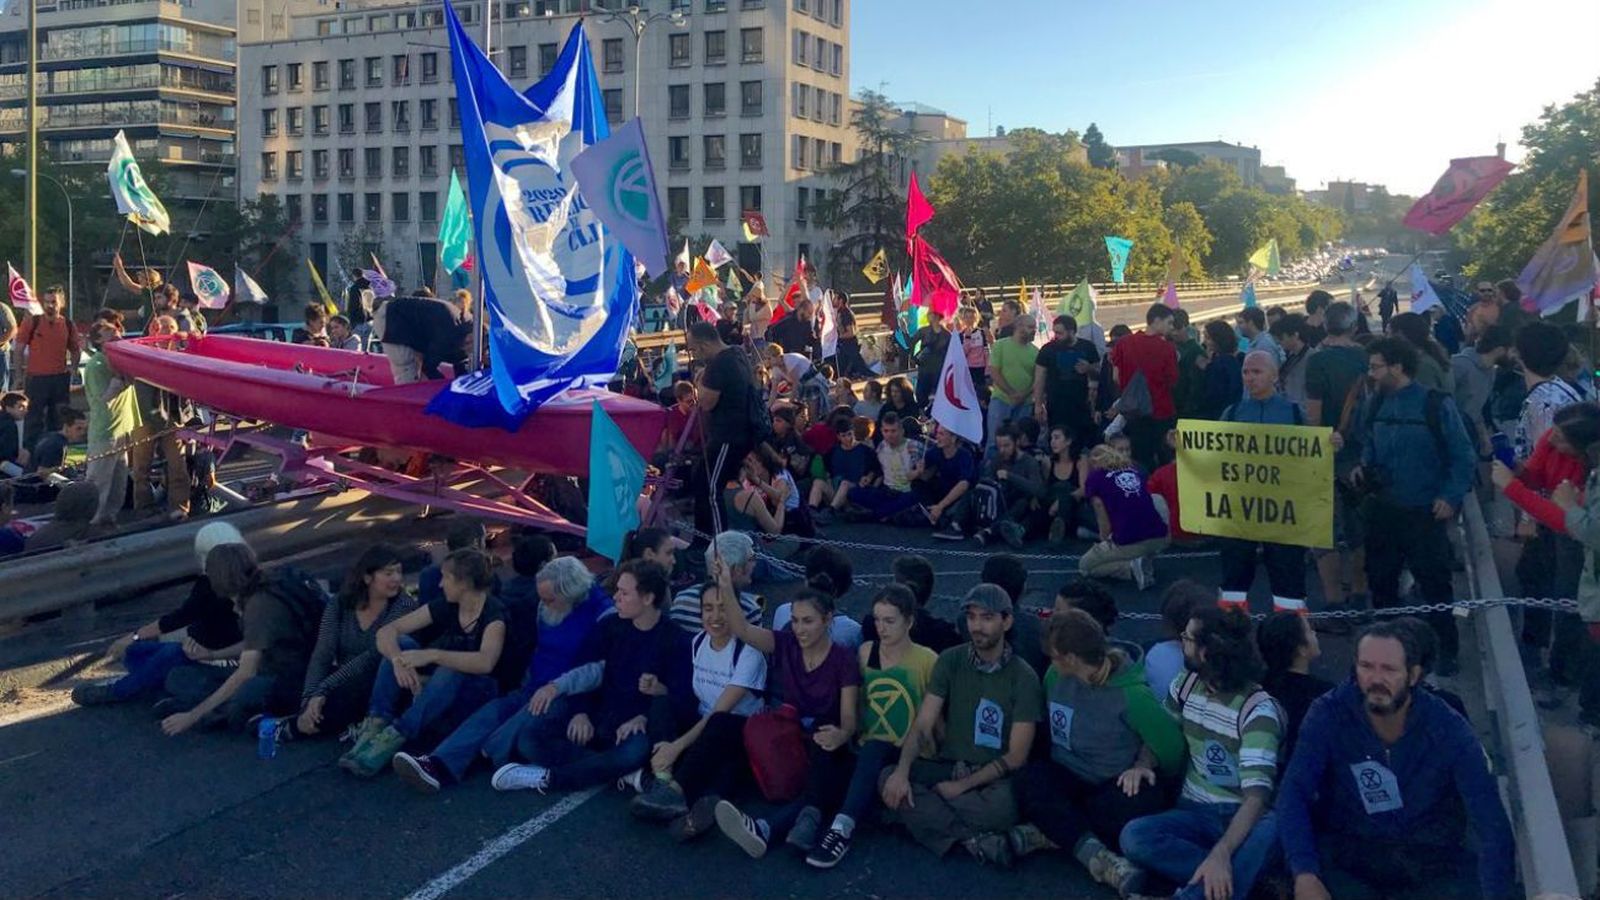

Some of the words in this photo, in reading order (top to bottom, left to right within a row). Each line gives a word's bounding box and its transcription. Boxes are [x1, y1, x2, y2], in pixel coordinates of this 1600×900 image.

[522, 187, 567, 203] 2020
[1182, 431, 1260, 456] NUESTRA
[1264, 434, 1322, 458] LUCHA
[1221, 462, 1240, 482] ES
[1245, 464, 1281, 486] POR
[1205, 492, 1232, 519] LA
[1240, 496, 1296, 525] VIDA
